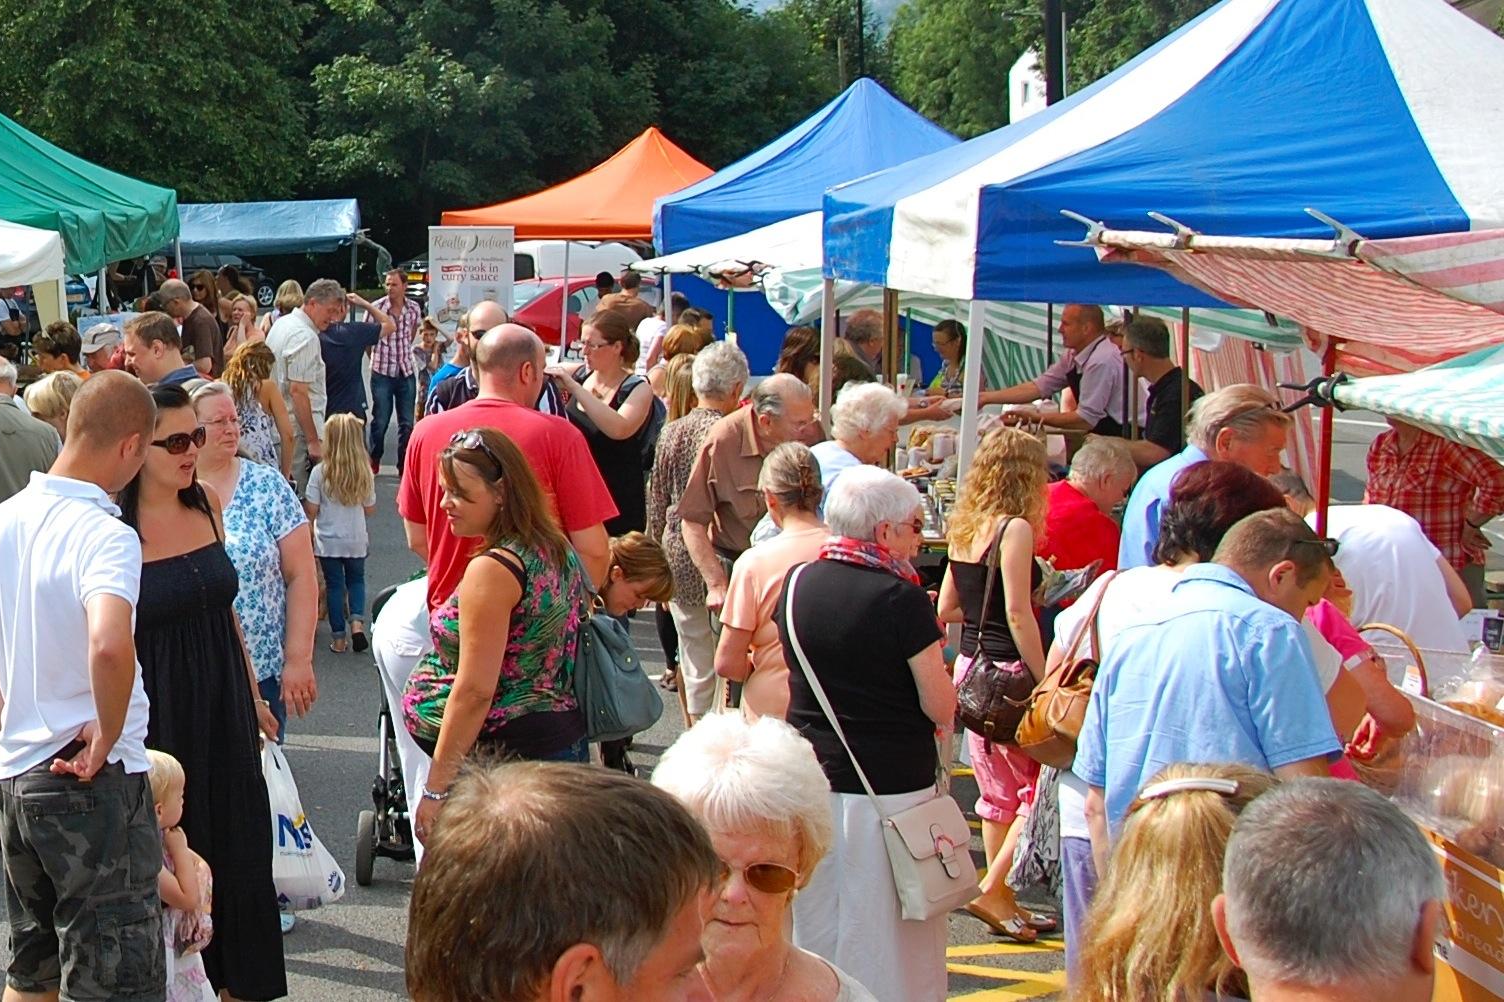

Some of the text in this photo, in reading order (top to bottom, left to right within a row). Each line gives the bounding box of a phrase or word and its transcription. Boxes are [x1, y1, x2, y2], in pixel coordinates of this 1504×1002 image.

[433, 235, 467, 249] Really
[463, 262, 486, 273] cook
[489, 262, 499, 273] in
[441, 273, 499, 283] curry sauce
